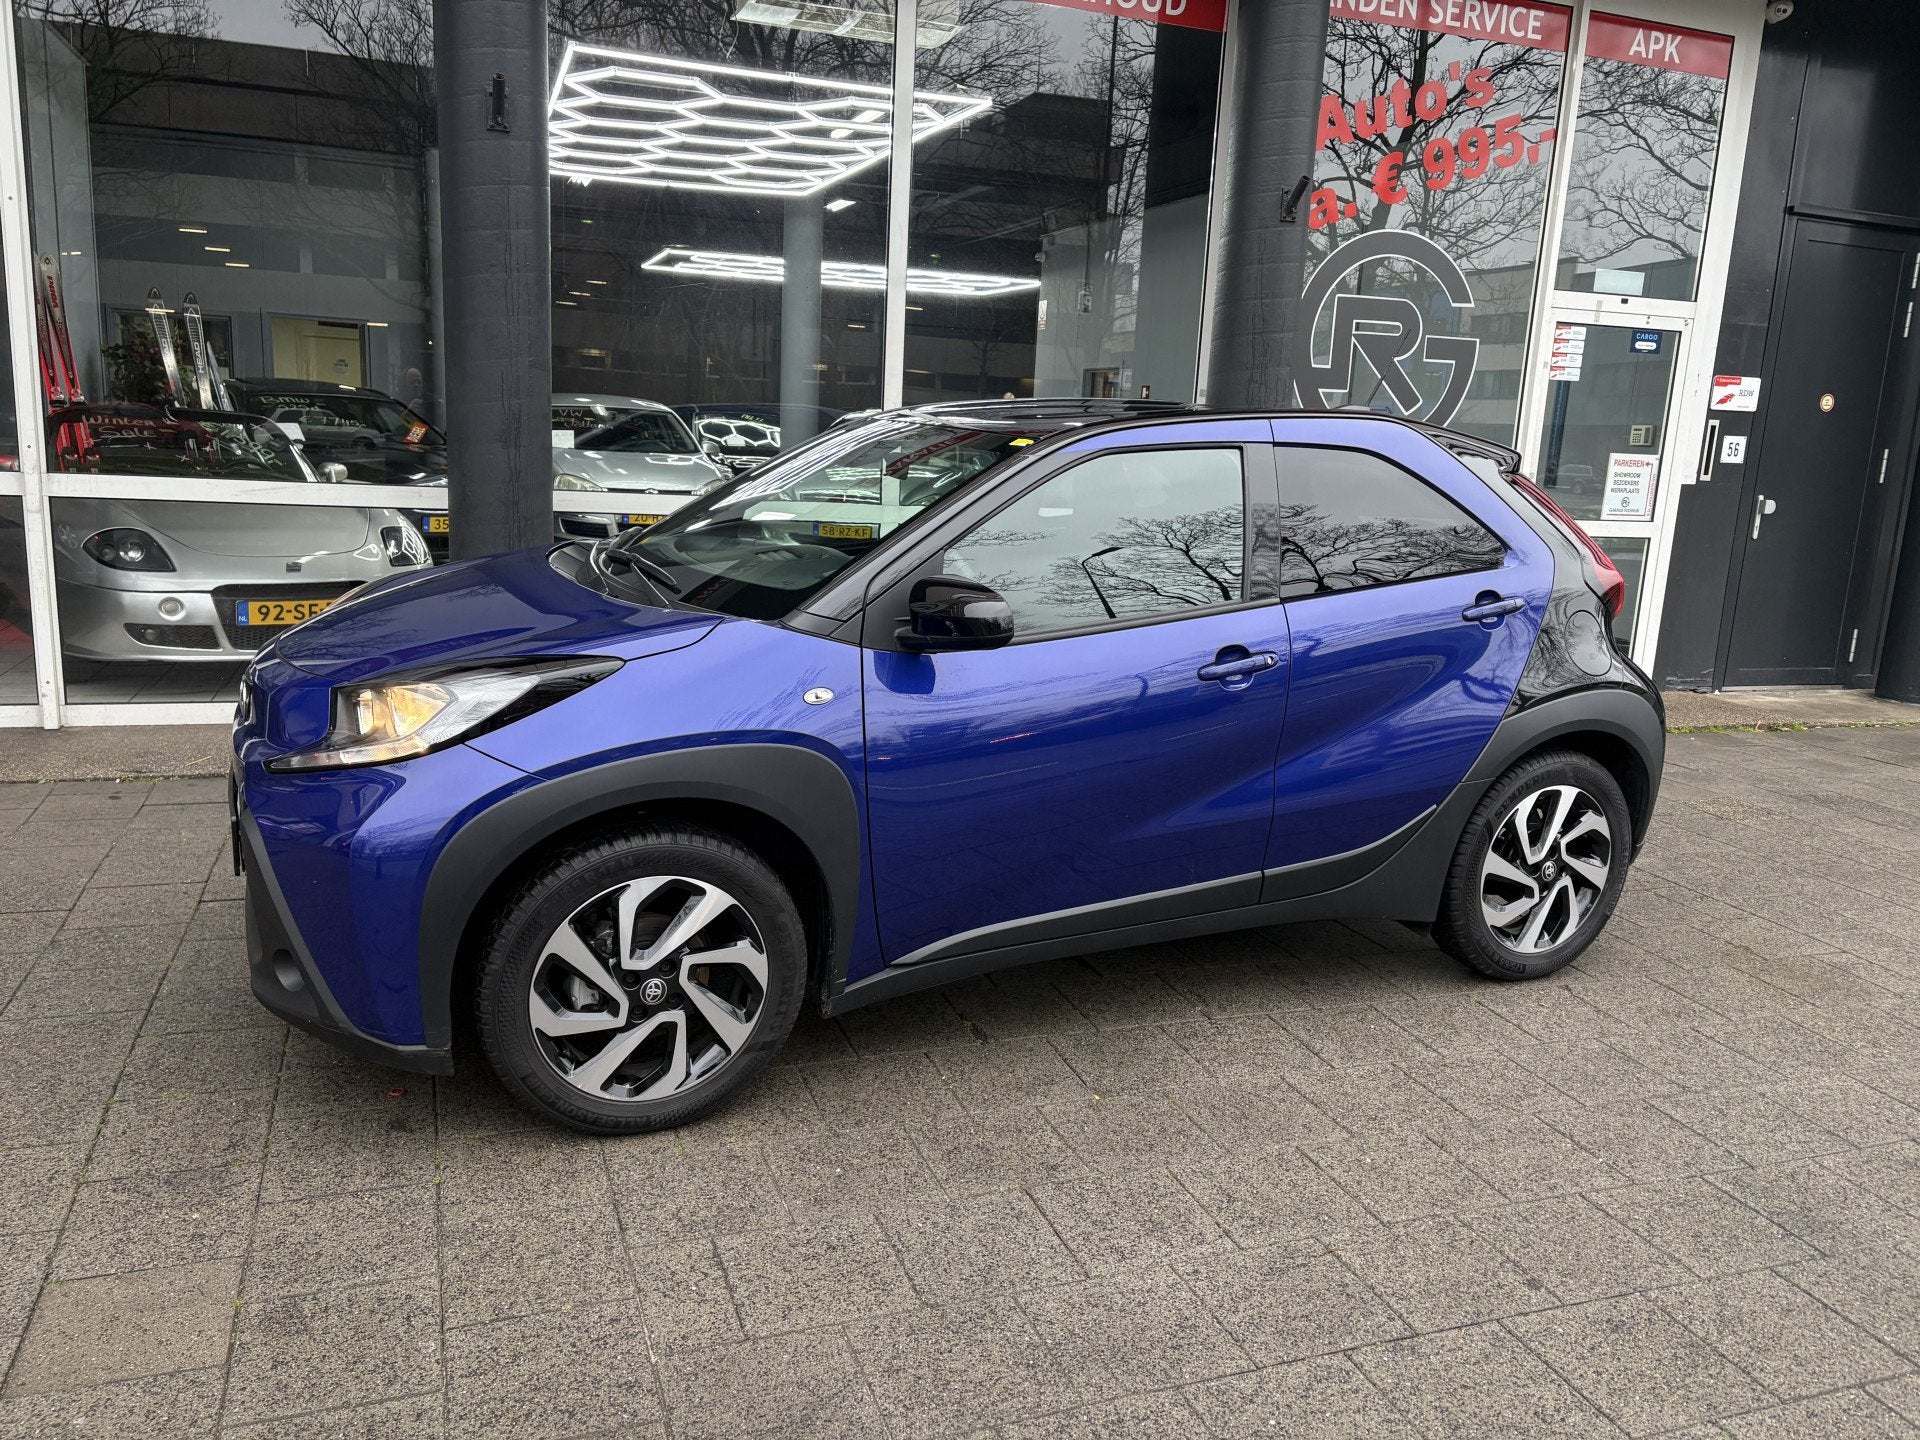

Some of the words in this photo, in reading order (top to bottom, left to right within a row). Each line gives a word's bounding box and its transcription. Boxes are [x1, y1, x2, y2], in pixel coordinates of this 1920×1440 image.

[1428, 0, 1545, 41] SERVICE
[1628, 27, 1683, 64] APK
[1315, 60, 1495, 150] Auto's
[1371, 151, 1408, 205] €
[1636, 332, 1659, 341] CARGO
[193, 341, 205, 374] HEAD
[1738, 389, 1755, 397] RDW
[559, 409, 583, 417] VW
[1727, 442, 1740, 457] 56
[1613, 458, 1645, 468] PARKEREN
[1613, 471, 1641, 479] SHOWROOM
[821, 525, 869, 537] 58-RZ-KF
[238, 615, 248, 623] NL
